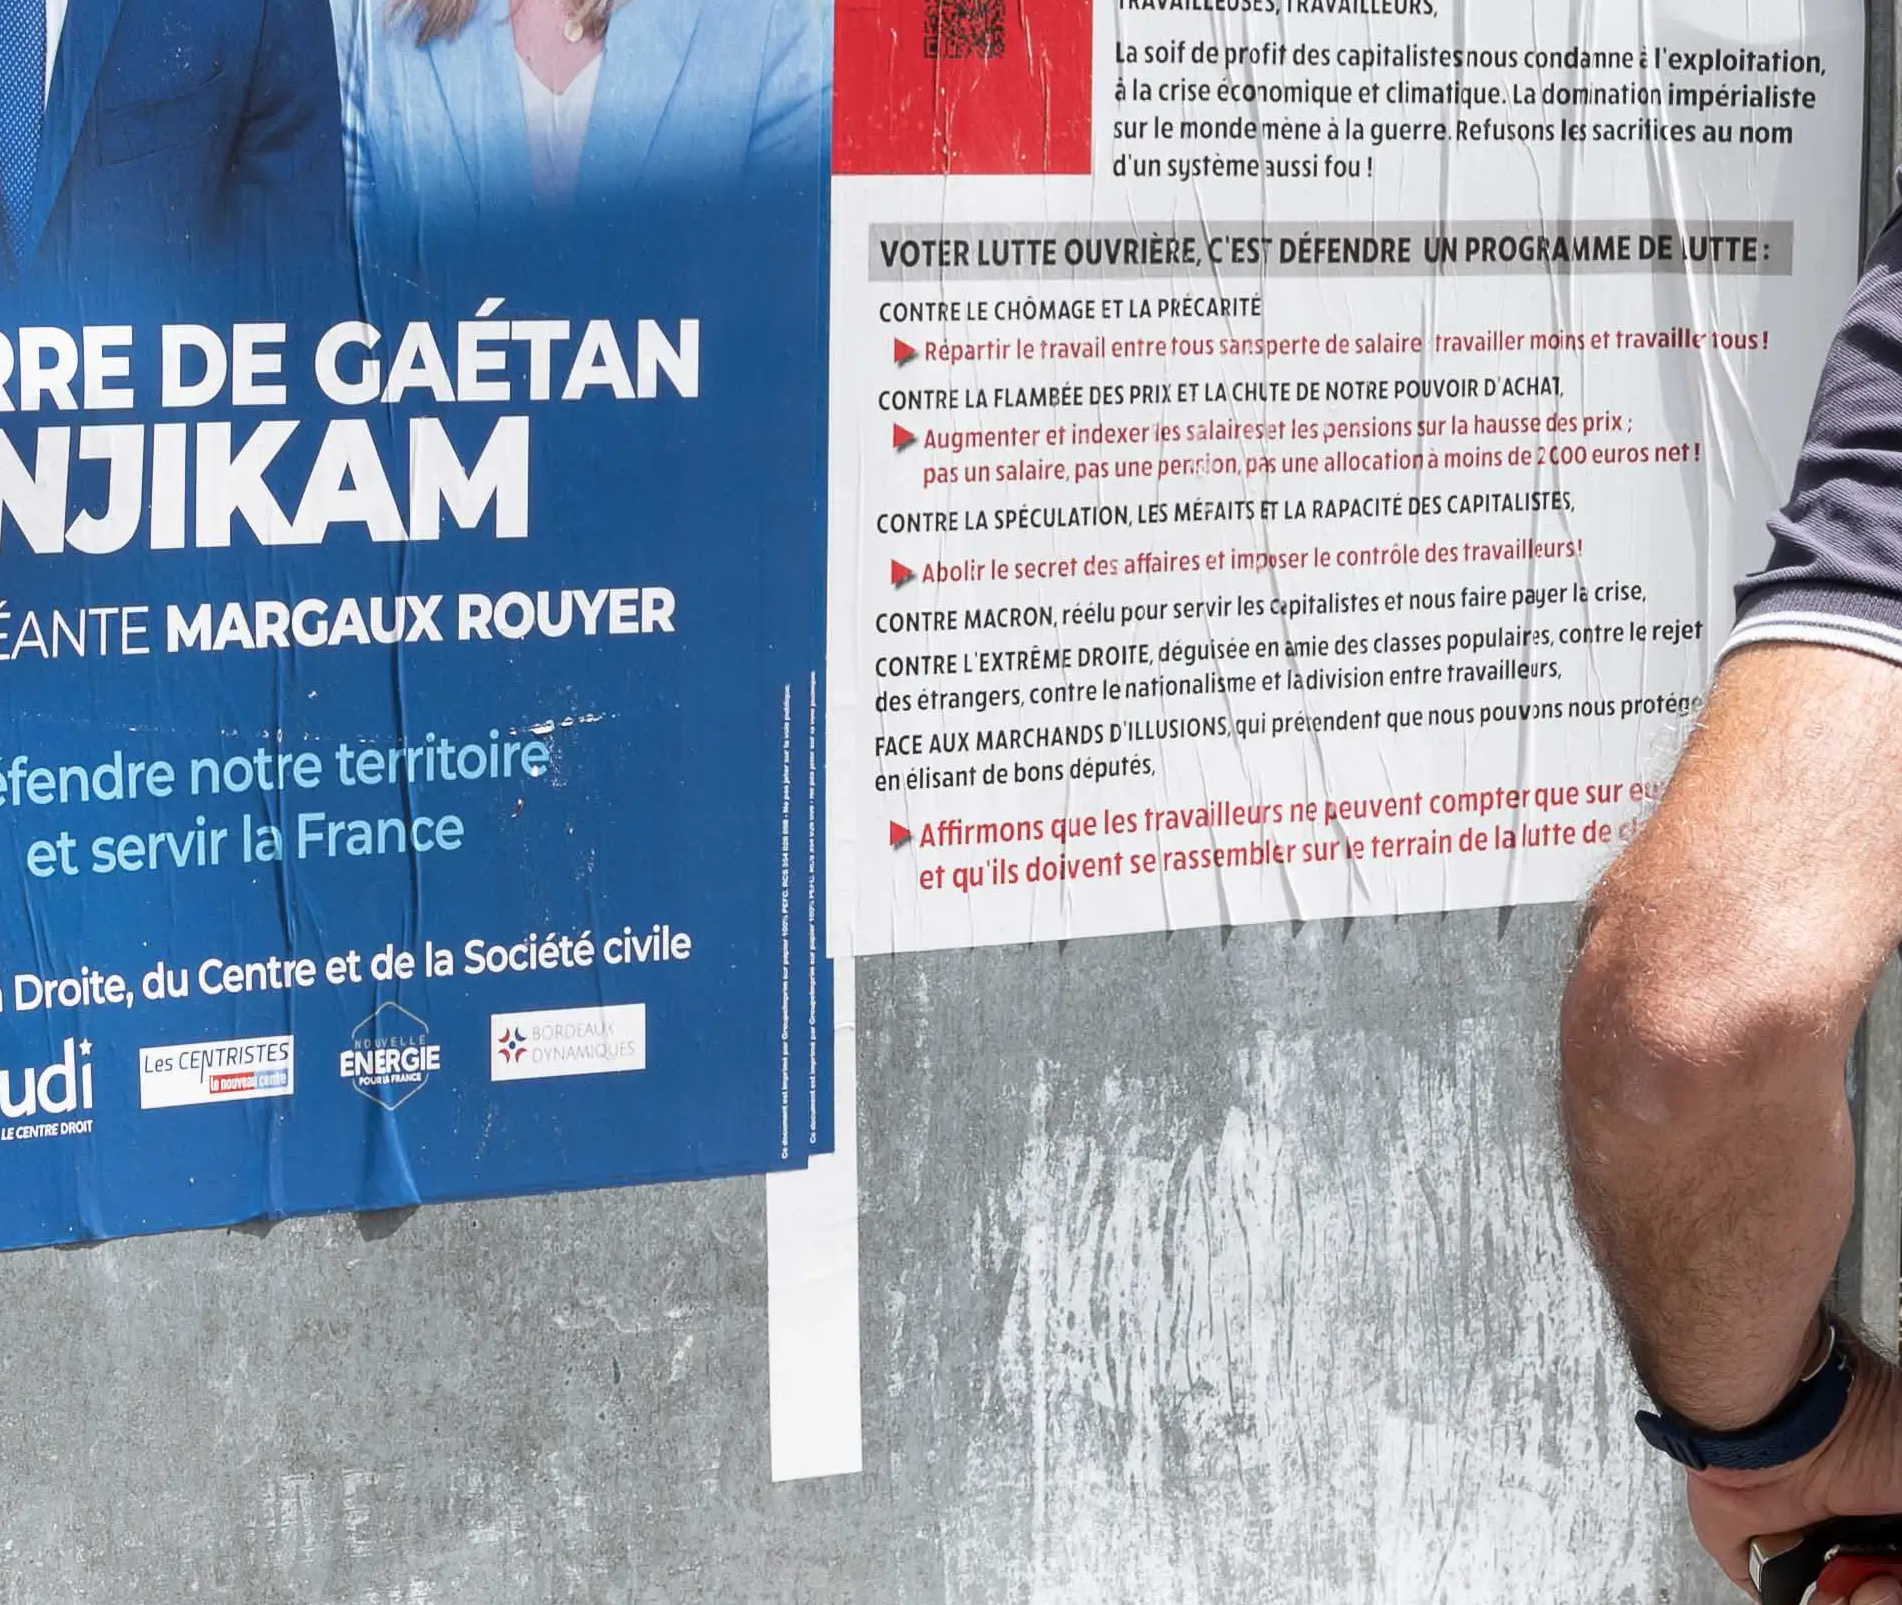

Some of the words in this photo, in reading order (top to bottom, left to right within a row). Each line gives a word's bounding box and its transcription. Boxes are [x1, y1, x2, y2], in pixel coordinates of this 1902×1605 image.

[880, 302, 960, 322] CONTRE
[968, 302, 987, 320] LE
[994, 291, 1095, 321] CHÔMAGE
[1102, 300, 1123, 318] ET
[1130, 299, 1151, 318] LA
[1158, 291, 1261, 317] PRÉCARITÉ
[162, 323, 286, 407] DE
[315, 298, 699, 404] GAÉTAN
[167, 595, 443, 652] MARGAUX
[459, 587, 675, 640] ROUYER
[191, 748, 322, 794] notre
[335, 725, 553, 785] territoire
[27, 832, 78, 877] et
[92, 816, 225, 873] servir
[244, 814, 282, 862] la
[298, 812, 464, 858] France
[15, 966, 133, 1010] Droite,
[143, 962, 188, 999] du
[199, 957, 316, 994] Centre
[326, 951, 362, 984] et
[371, 944, 414, 980] de
[426, 941, 453, 977] la
[465, 930, 594, 974] Société
[604, 925, 691, 964] civile
[0, 1038, 92, 1117] udi
[144, 1054, 174, 1074] Les
[178, 1042, 290, 1084] CENTRISTES
